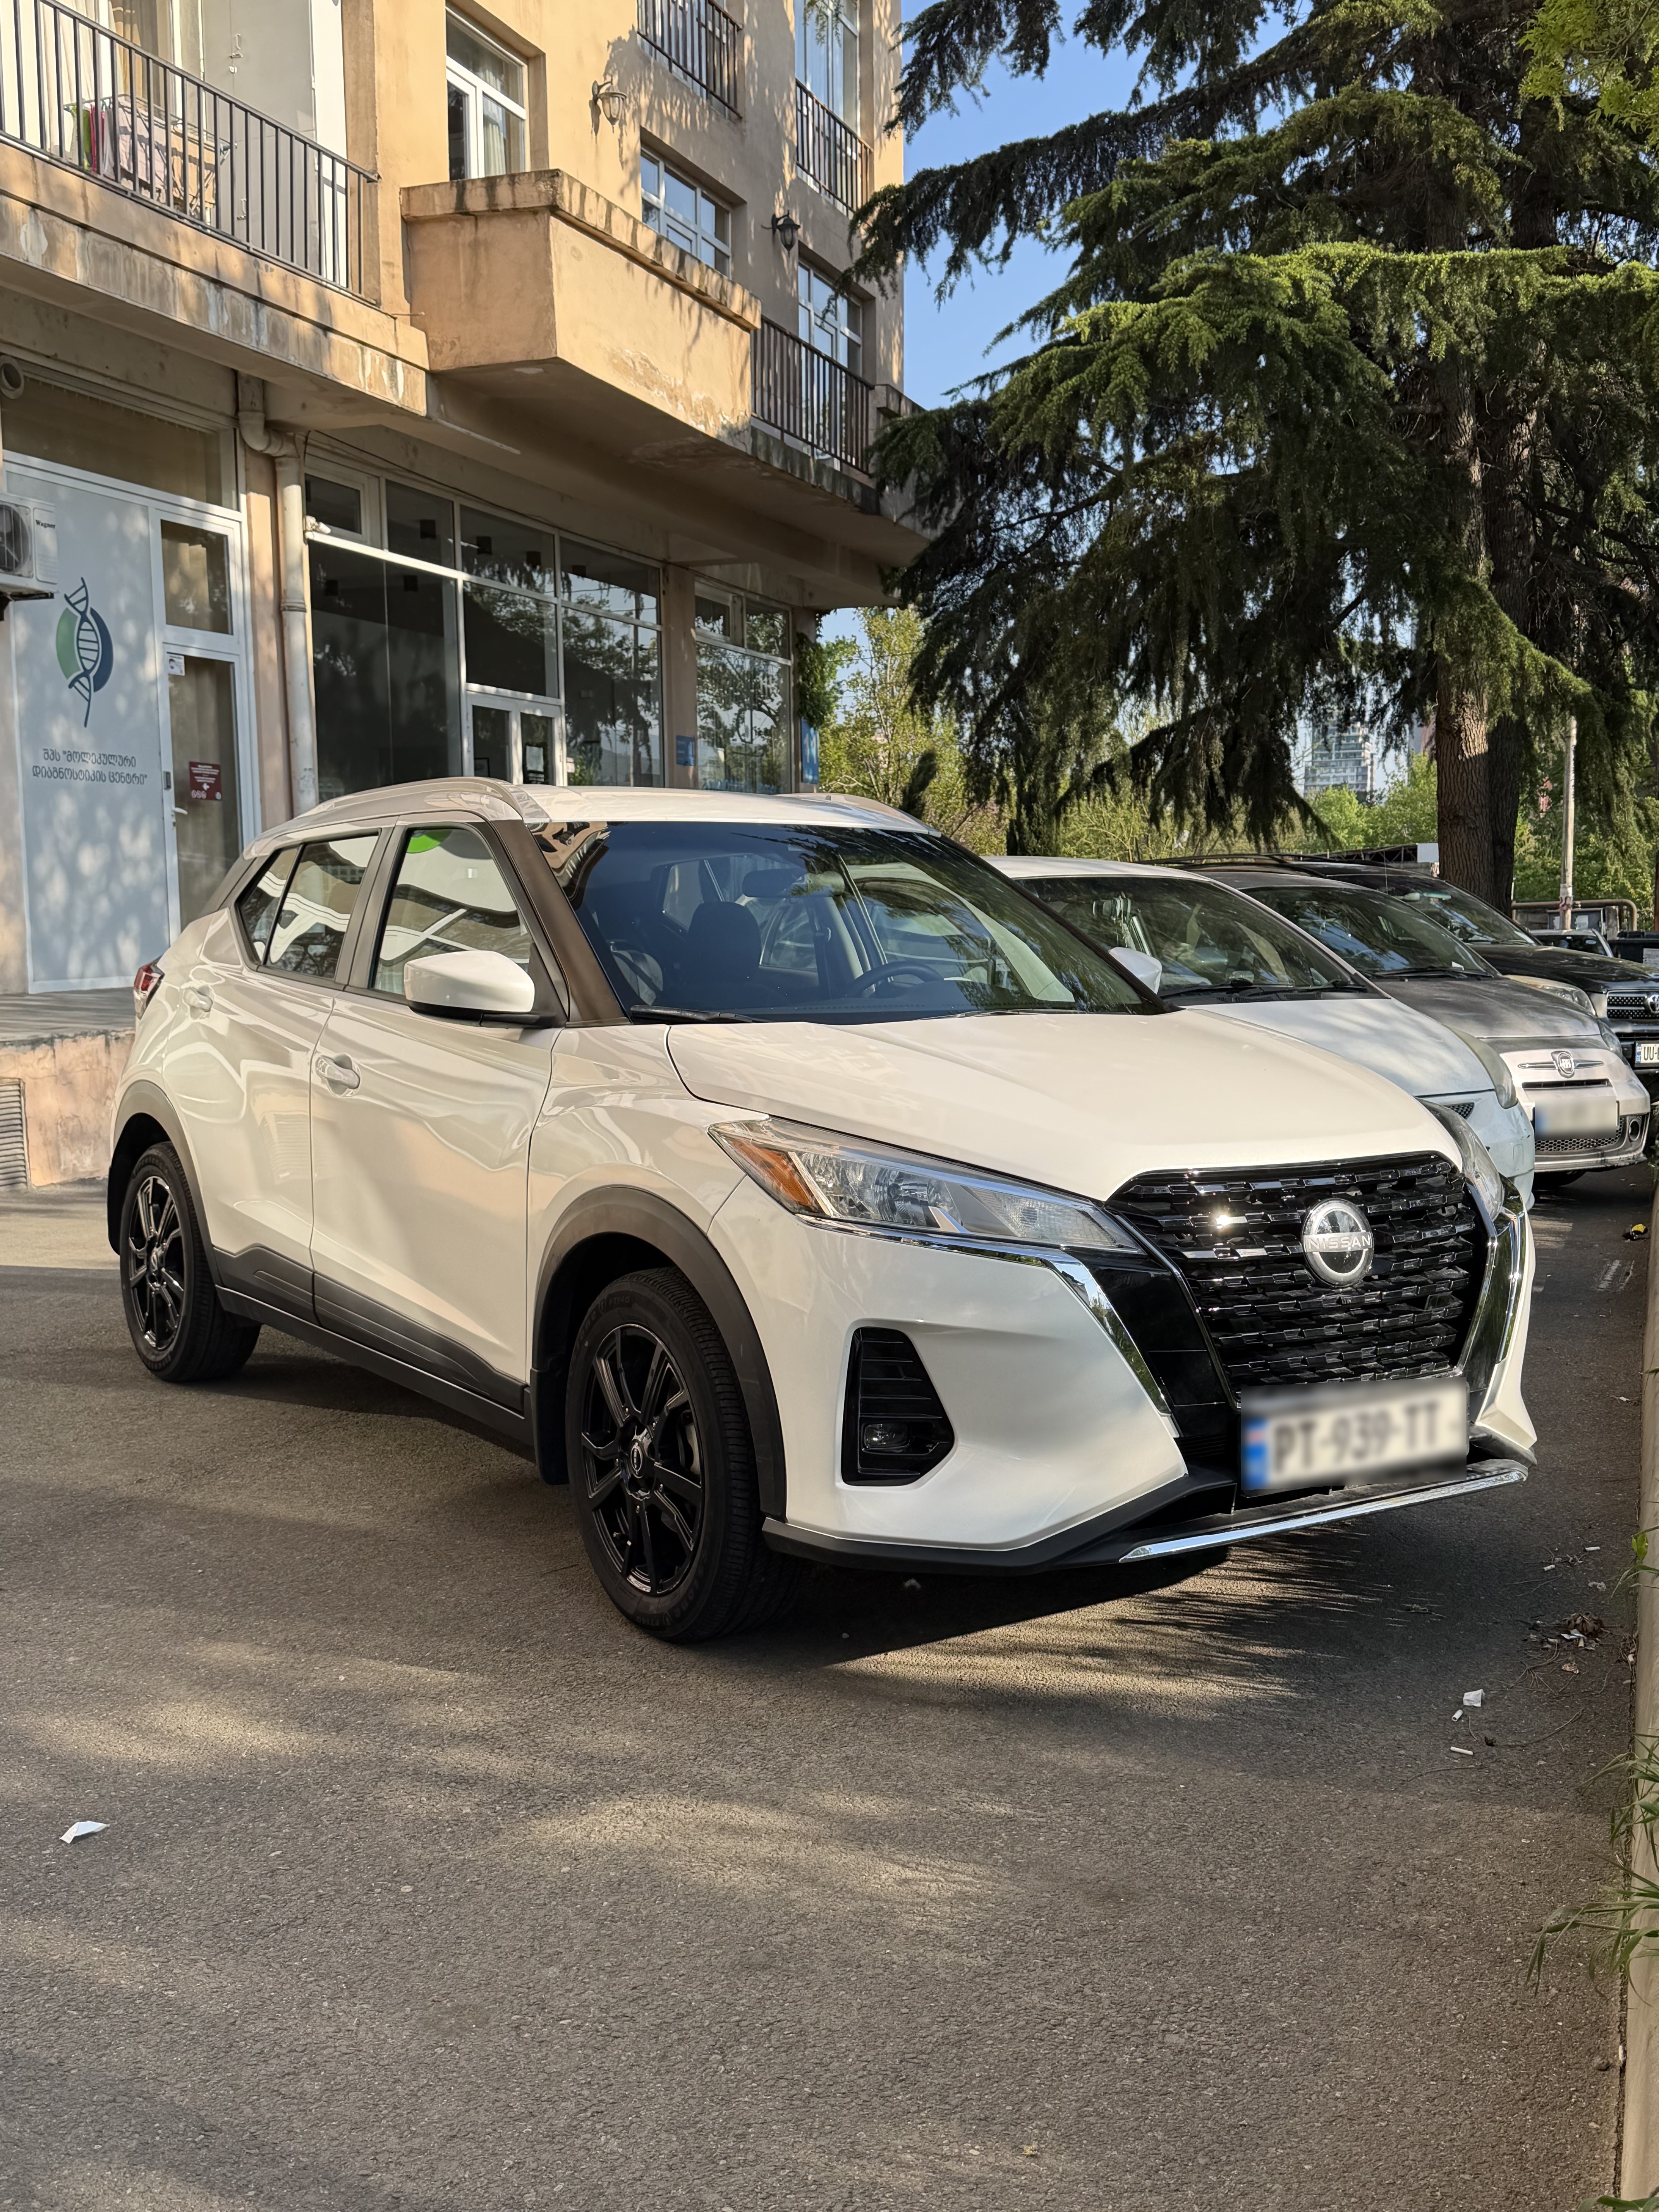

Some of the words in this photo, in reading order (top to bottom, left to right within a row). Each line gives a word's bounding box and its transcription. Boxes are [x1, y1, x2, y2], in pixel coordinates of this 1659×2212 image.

[43, 748, 60, 761] შპს
[32, 766, 106, 782] დიაგნოსტიკის
[1309, 1235, 1371, 1249] NISSAN
